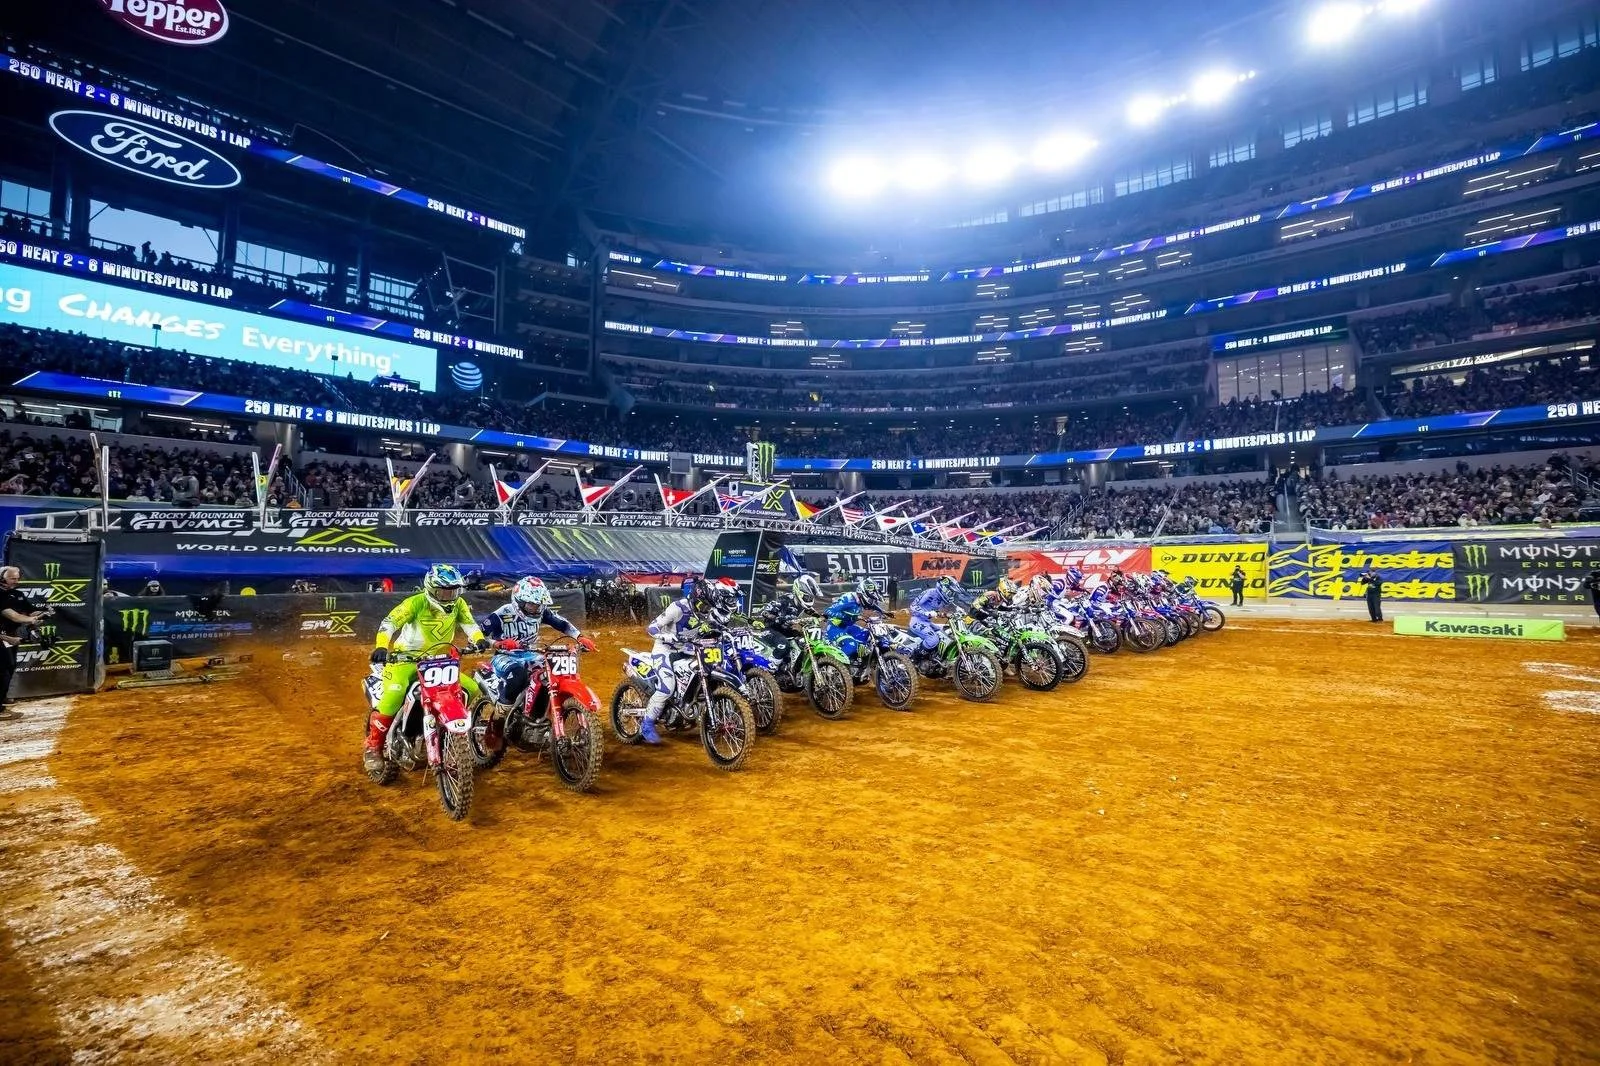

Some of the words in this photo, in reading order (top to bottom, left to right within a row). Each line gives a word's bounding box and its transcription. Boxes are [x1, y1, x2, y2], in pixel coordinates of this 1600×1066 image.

[175, 24, 206, 37] Est.1885
[9, 59, 41, 79] 250
[46, 71, 81, 93] HEAT
[86, 85, 95, 98] 2
[110, 93, 119, 108] 6
[124, 97, 217, 138] MINUTES/PLUS
[221, 130, 227, 144] 1
[229, 132, 251, 150] LAP
[91, 122, 209, 181] Ford
[1371, 183, 1385, 193] 250
[1387, 178, 1403, 189] HEAT
[1486, 152, 1501, 163] LAP
[427, 198, 445, 213] 250
[446, 203, 466, 220] HEAT
[467, 211, 474, 222] 2
[1566, 224, 1586, 236] 250
[23, 244, 59, 264] HEAT
[63, 253, 73, 267] 2
[89, 258, 98, 272] 6
[102, 261, 199, 294] MINUTES/PLUS
[201, 281, 208, 296] 1
[211, 286, 233, 300] LAP
[1278, 286, 1291, 295] 250
[1293, 281, 1309, 292] HEAT
[1310, 281, 1316, 289] 2
[1385, 265, 1389, 274] 1
[1391, 263, 1406, 274] LAP
[58, 293, 225, 340] CHANGES
[242, 327, 392, 374] Everything
[413, 328, 430, 341] 250
[432, 331, 452, 346] HEAT
[453, 336, 460, 347] 2
[245, 400, 270, 415] 250
[274, 403, 303, 419] HEAT
[305, 407, 313, 421] 2
[325, 410, 333, 423] 6
[337, 411, 413, 433] MINUTES/PLUS
[415, 422, 420, 433] 1
[422, 423, 441, 436] LAP
[1547, 402, 1577, 418] 250
[588, 444, 603, 456] 250
[604, 446, 621, 457] HEAT
[622, 447, 627, 458] 2
[634, 448, 639, 459] 6
[1144, 444, 1161, 456] 250
[1164, 442, 1185, 454] HEAT
[1187, 441, 1195, 452] 2
[1204, 440, 1210, 451] 6
[1213, 433, 1285, 450] MINUTES/PLUS
[1288, 432, 1293, 443] 1
[1295, 430, 1316, 442] LAP
[693, 453, 724, 465] ES/PLUS
[730, 456, 744, 466] LAP
[872, 459, 886, 470] 250
[887, 459, 905, 470] HEAT
[906, 459, 911, 469] 2
[981, 457, 985, 467] 1
[986, 457, 1000, 467] LAP
[150, 512, 186, 520] ROCKY
[190, 512, 245, 520] MOUNTAIN
[304, 510, 332, 518] ROCKY
[335, 510, 380, 518] MOUNTAIN
[176, 543, 258, 552] WORLD
[264, 546, 411, 554] CHAMPIONSHIP
[1180, 551, 1266, 563] DUNLO
[827, 554, 868, 573] 5.11
[1314, 550, 1455, 574] alpinestars
[1195, 578, 1266, 588] UNO
[1502, 575, 1586, 592] MONS
[175, 609, 231, 618] MONER
[300, 615, 357, 633] SMX
[1425, 621, 1523, 636] Kawasaki
[16, 645, 82, 665] SMX
[704, 648, 722, 663] 30
[552, 656, 577, 676] 296
[423, 665, 459, 688] 90
